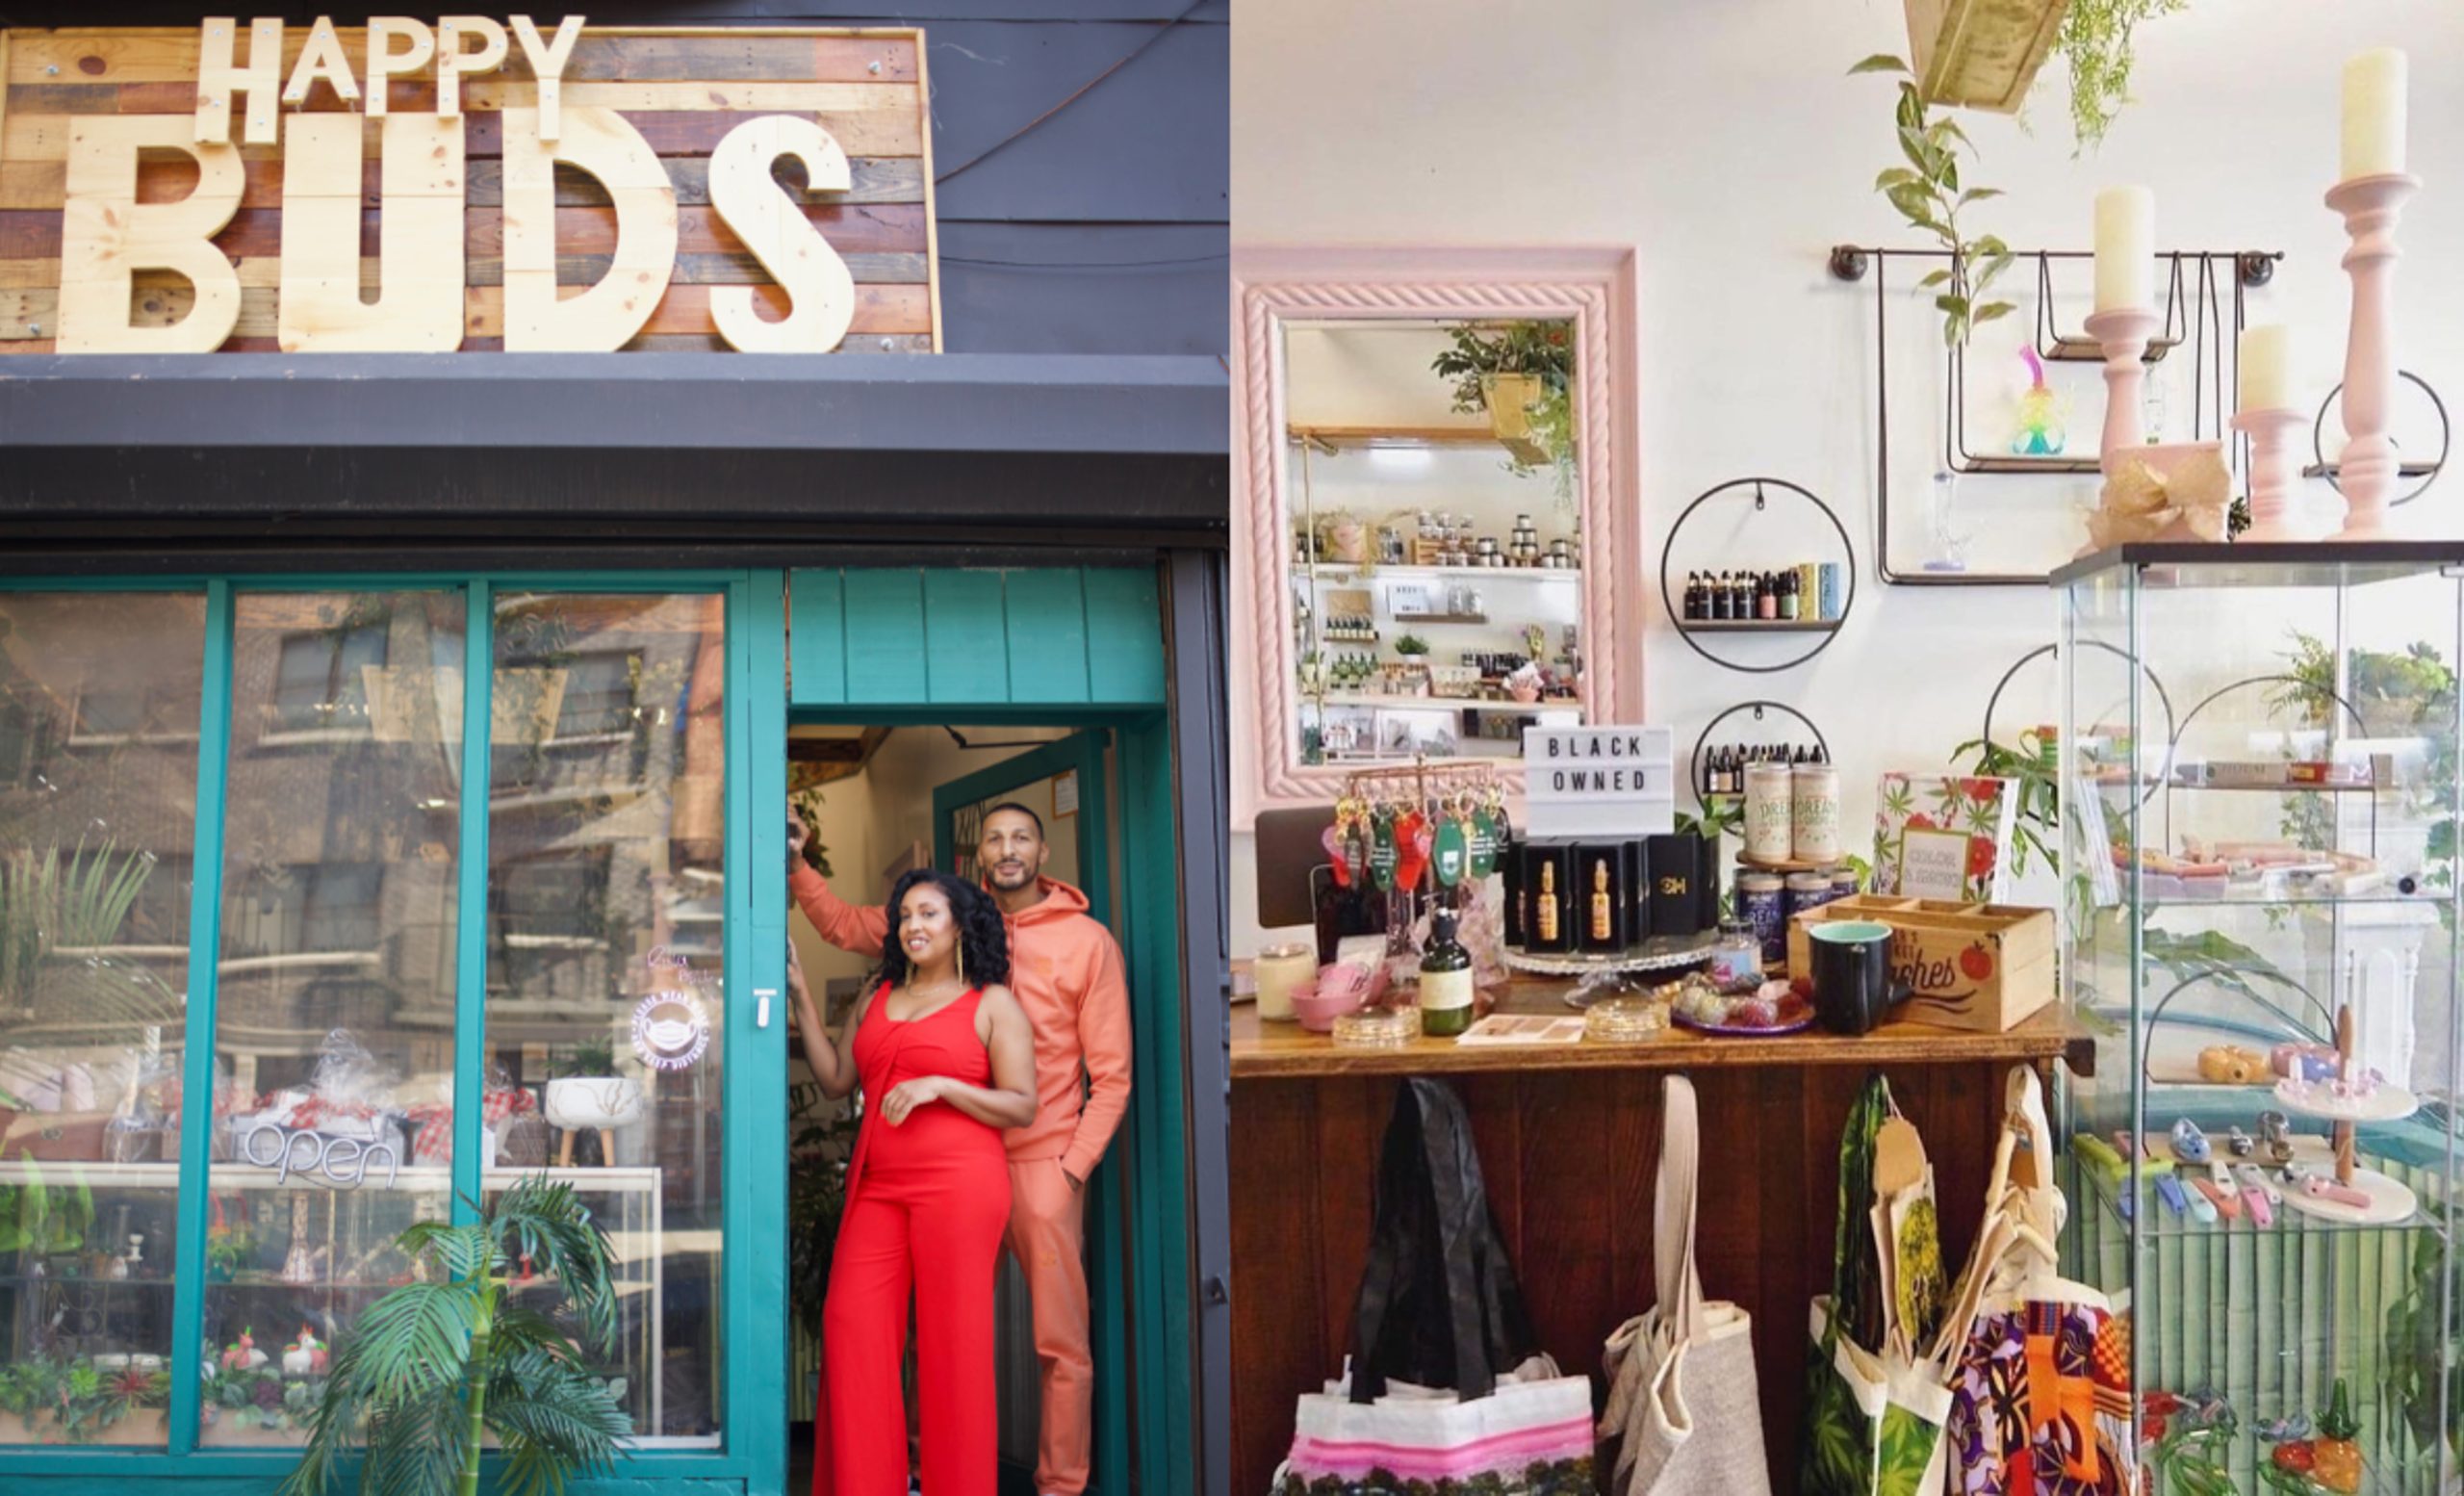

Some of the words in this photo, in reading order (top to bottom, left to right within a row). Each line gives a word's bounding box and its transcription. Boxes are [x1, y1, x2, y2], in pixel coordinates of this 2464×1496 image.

[195, 14, 586, 144] HAPPY
[56, 106, 857, 354] BUDS
[1548, 735, 1640, 758] BLACK
[1553, 770, 1645, 791] OWNED
[245, 1123, 396, 1191] open
